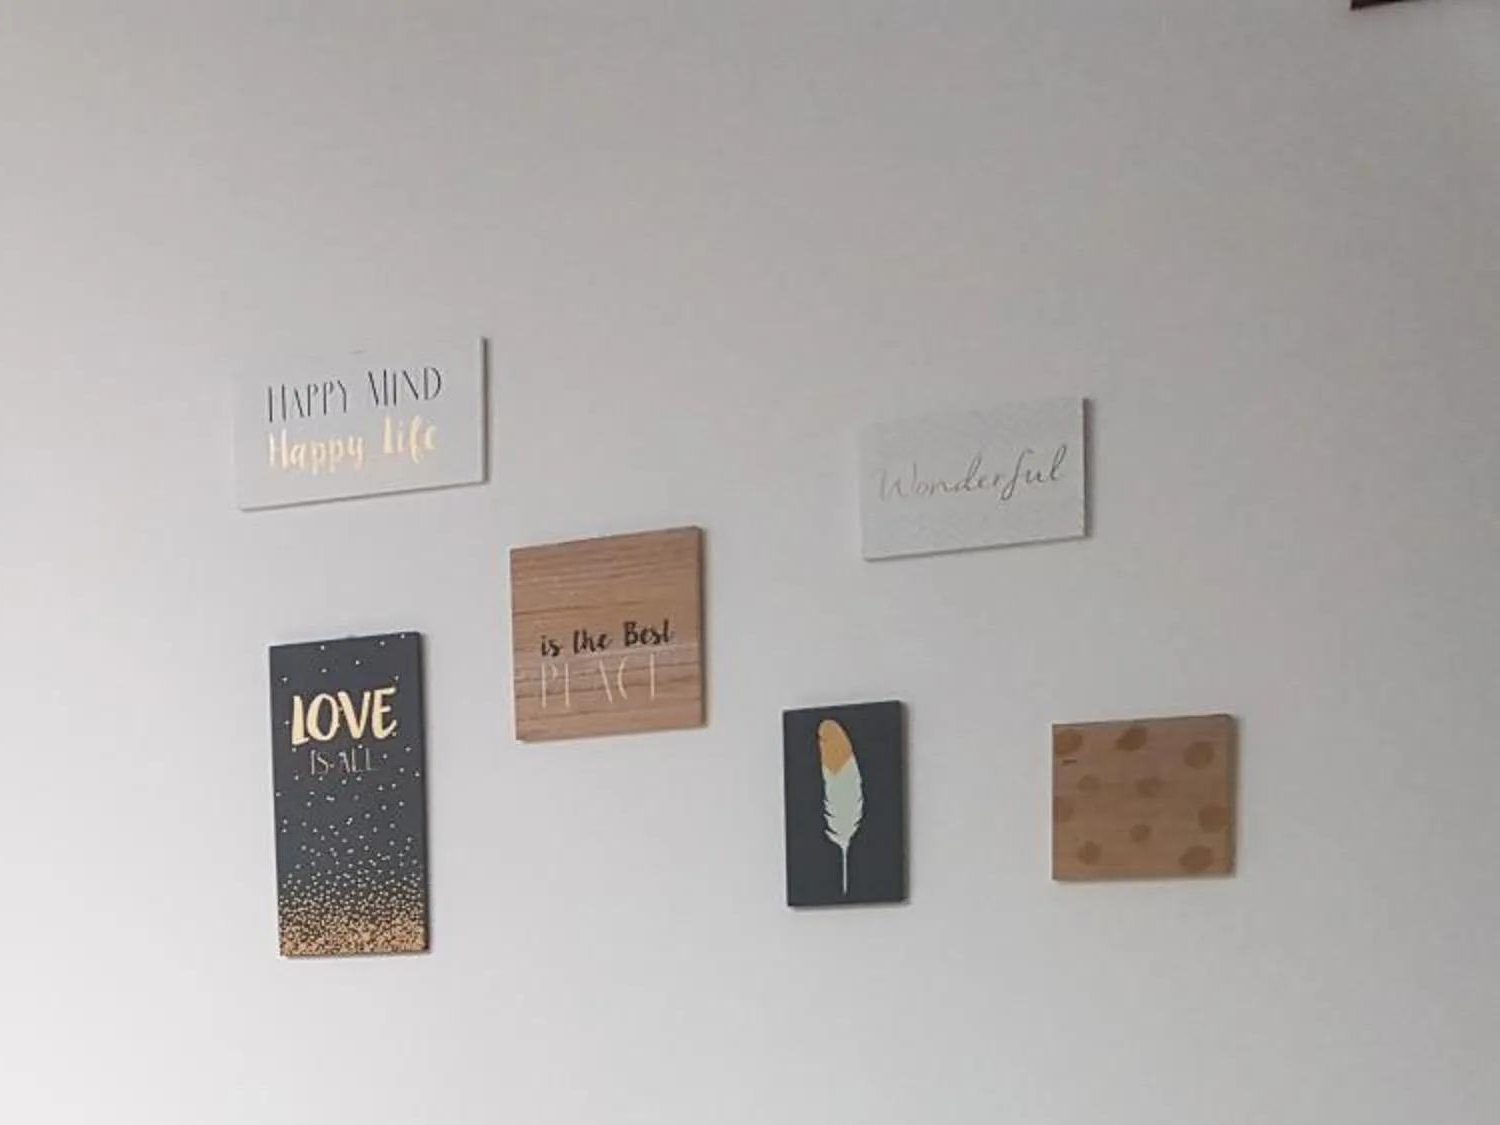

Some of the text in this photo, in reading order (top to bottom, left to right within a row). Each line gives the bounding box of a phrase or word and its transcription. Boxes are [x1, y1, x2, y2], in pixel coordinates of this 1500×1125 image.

[267, 366, 442, 423] HAPPY MIND
[267, 427, 365, 476] Happy
[541, 618, 674, 657] is the Best
[291, 686, 397, 745] LOVE
